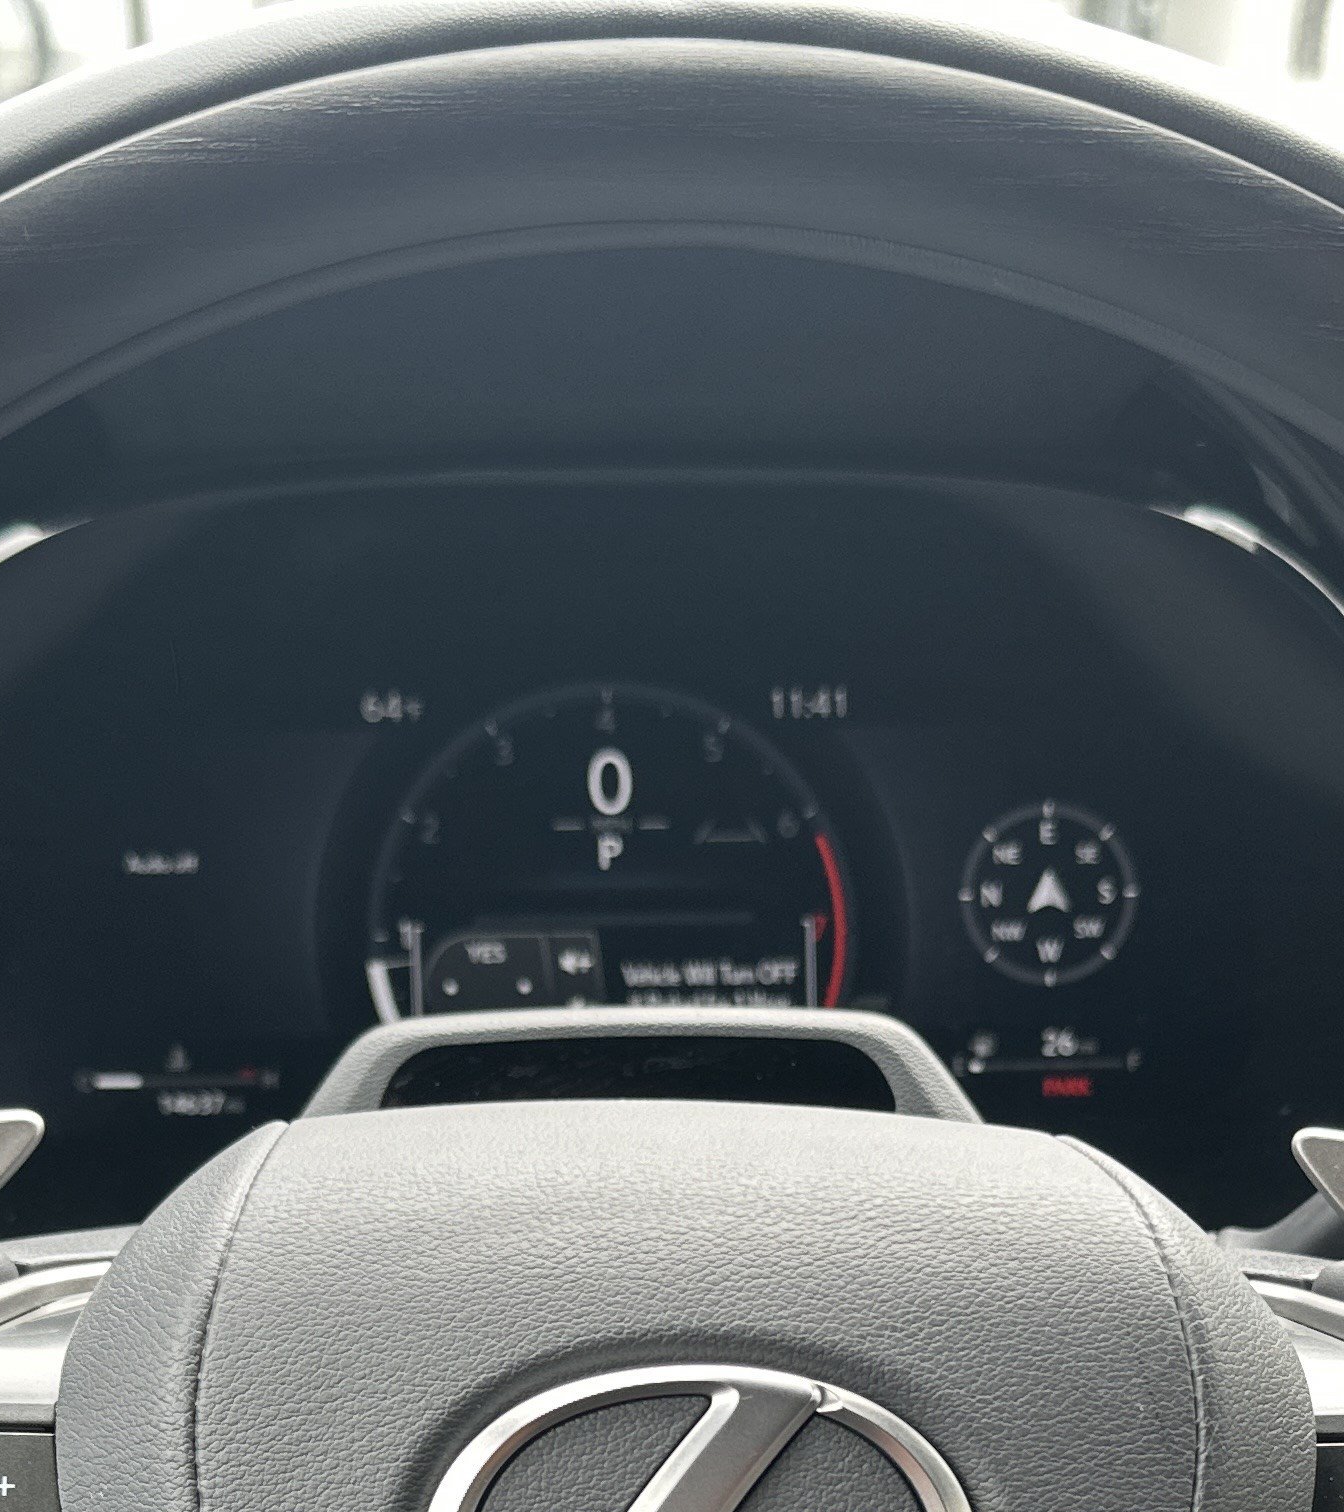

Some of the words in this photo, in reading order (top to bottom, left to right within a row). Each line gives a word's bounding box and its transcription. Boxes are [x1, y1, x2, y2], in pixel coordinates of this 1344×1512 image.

[770, 685, 848, 719] 11:41
[587, 746, 633, 816] 0
[1038, 819, 1057, 845] E
[597, 832, 624, 870] P
[979, 880, 1003, 909] N
[1096, 877, 1117, 905] S
[1036, 937, 1065, 963] W
[757, 957, 798, 986] OFF
